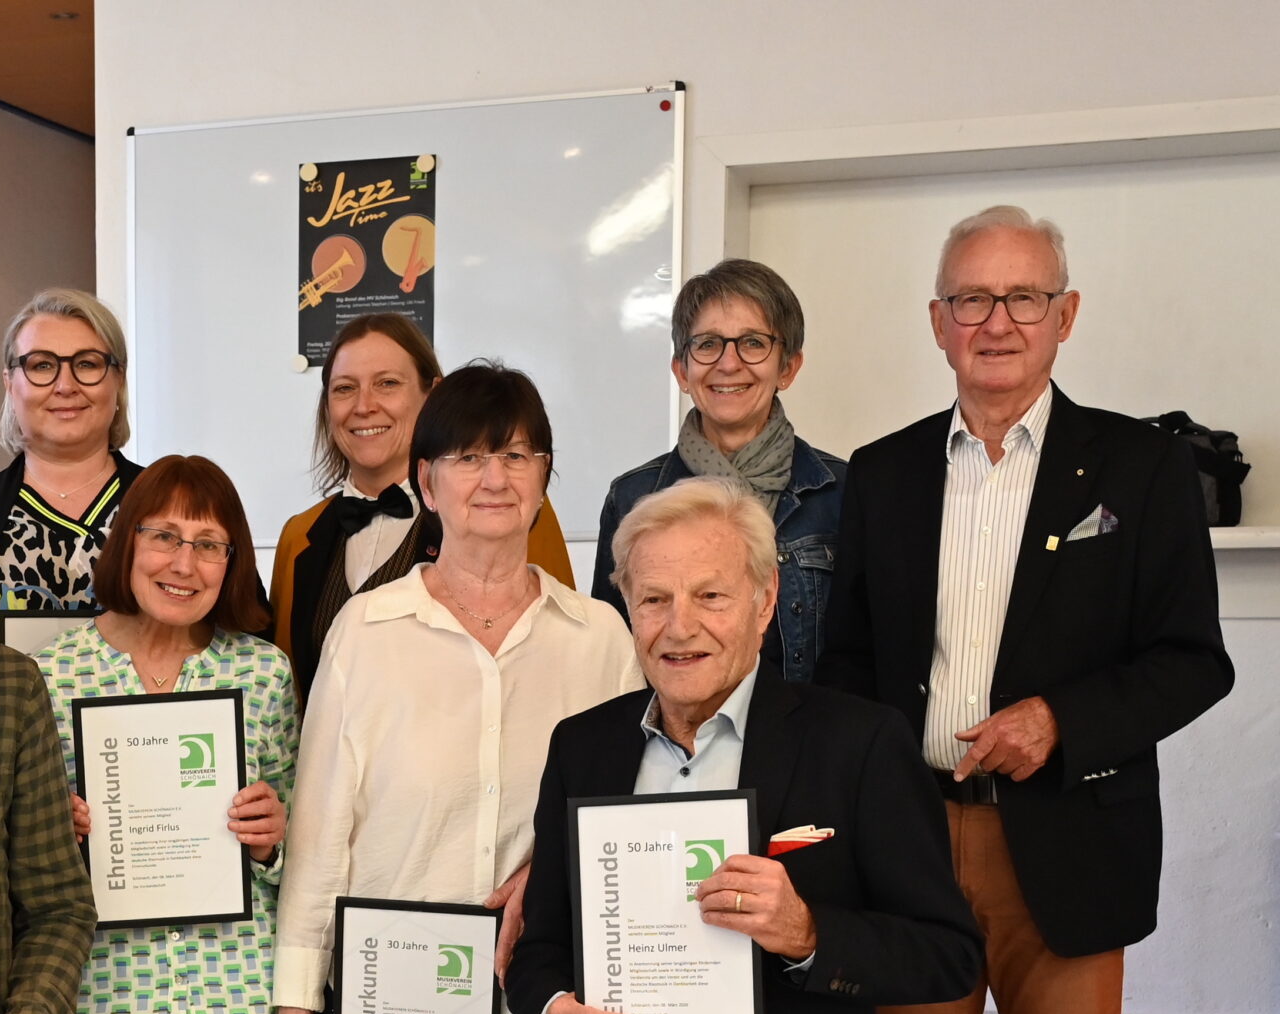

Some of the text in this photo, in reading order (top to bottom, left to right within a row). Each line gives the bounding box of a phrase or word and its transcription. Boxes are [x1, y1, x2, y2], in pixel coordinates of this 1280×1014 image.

[306, 172, 395, 228] Jazz
[349, 208, 389, 228] Time
[126, 736, 169, 747] 50 Jahre
[99, 737, 126, 892] Ehrenurkunde
[129, 823, 180, 836] Ingrid Firlus
[627, 841, 674, 853] 50 Jahre
[387, 940, 429, 952] 30 Jahre
[628, 943, 688, 953] Heinz Ulmer
